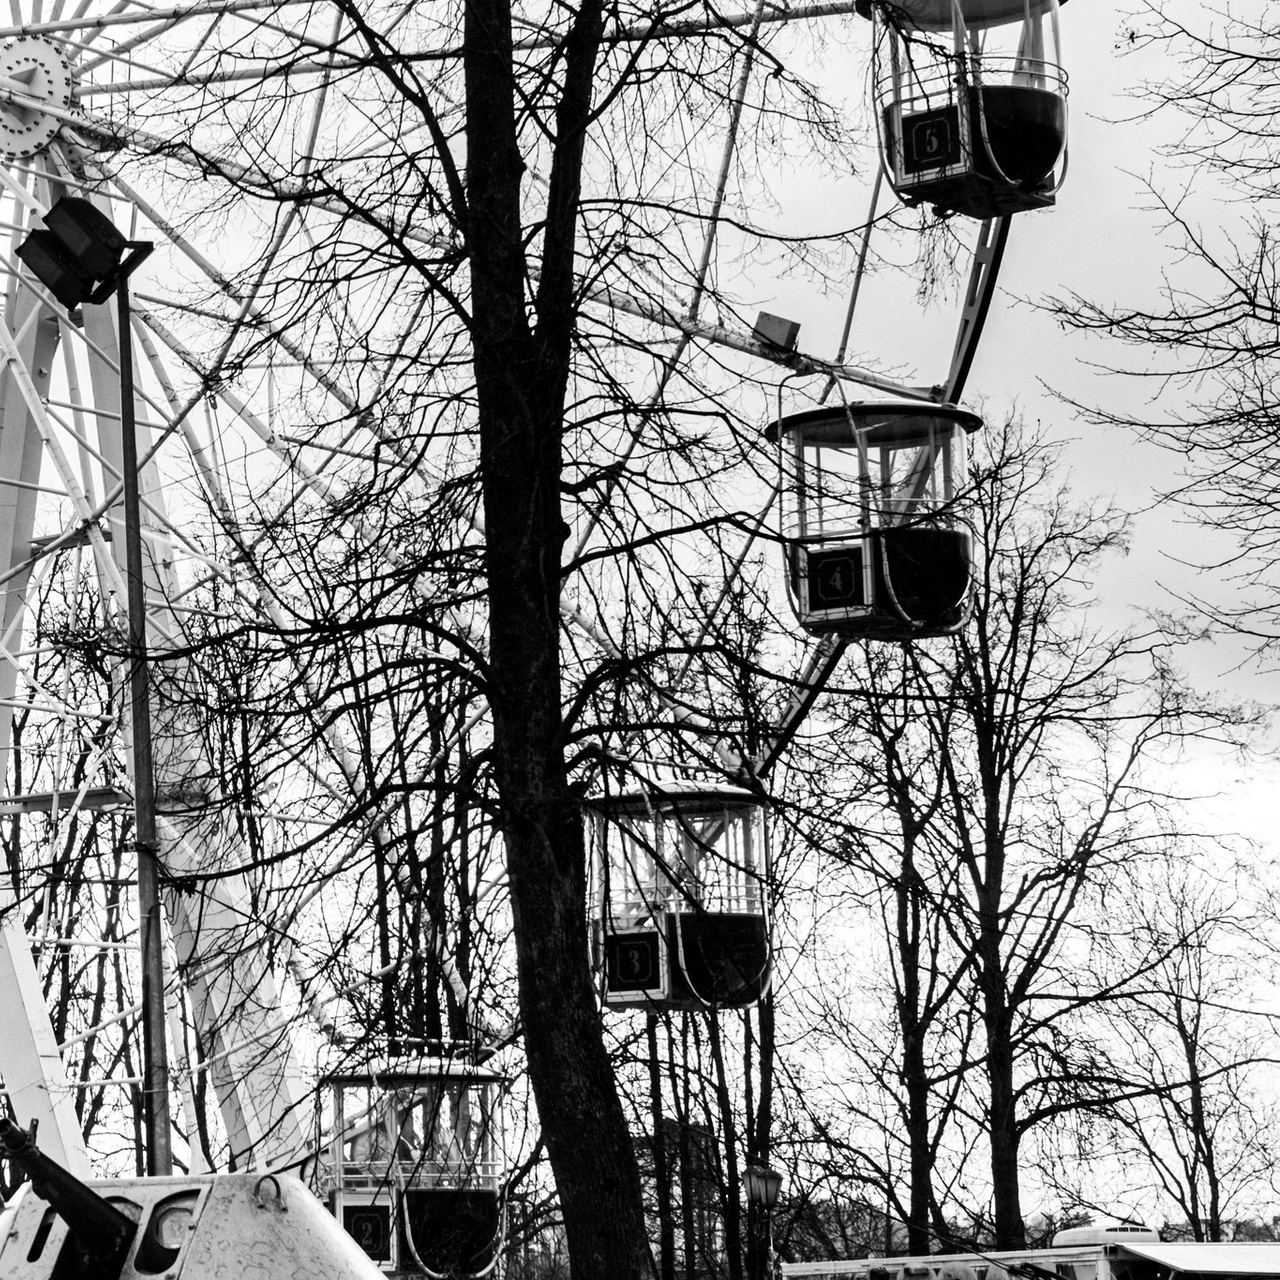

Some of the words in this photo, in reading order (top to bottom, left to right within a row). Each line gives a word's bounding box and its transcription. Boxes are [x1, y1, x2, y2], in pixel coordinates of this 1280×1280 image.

[926, 128, 938, 152] 5
[829, 566, 842, 591] 4
[629, 950, 640, 974] 3
[362, 1221, 373, 1245] 2
